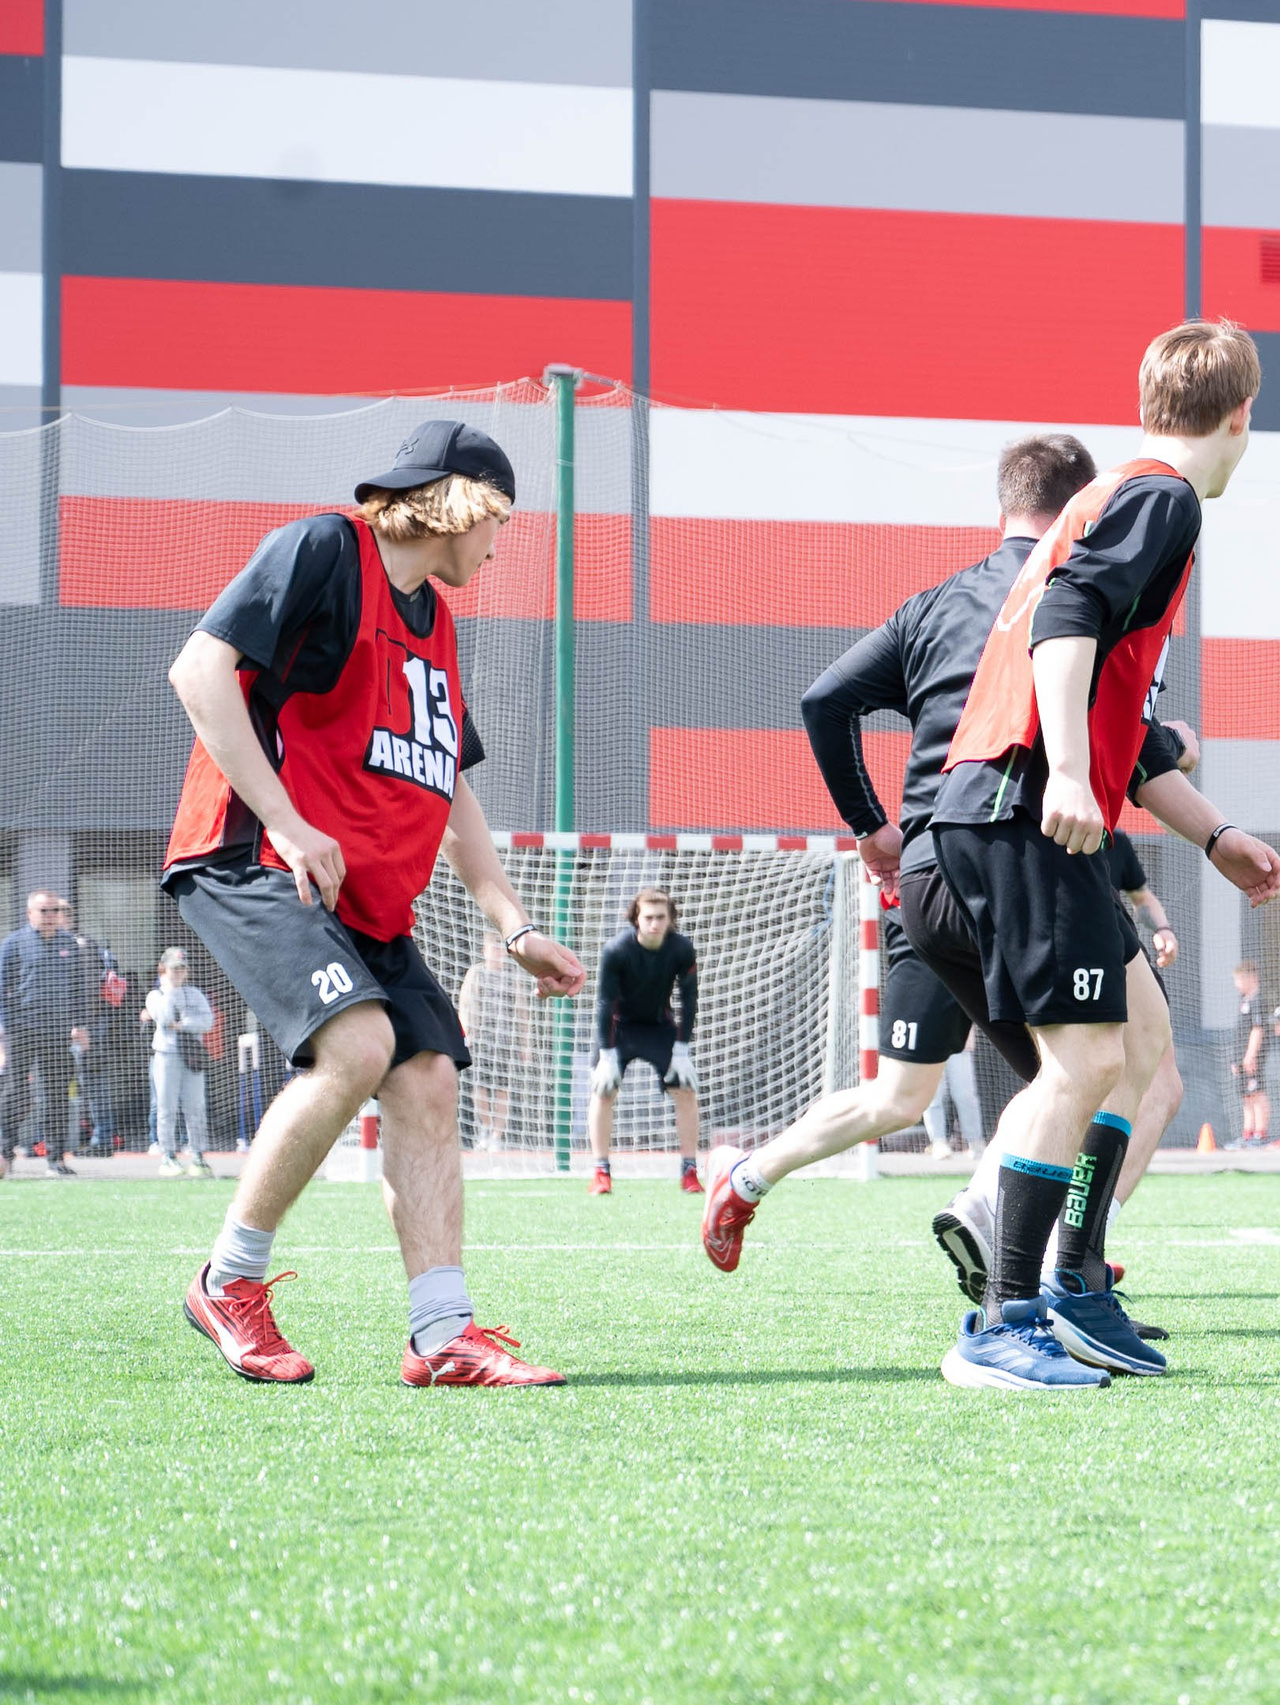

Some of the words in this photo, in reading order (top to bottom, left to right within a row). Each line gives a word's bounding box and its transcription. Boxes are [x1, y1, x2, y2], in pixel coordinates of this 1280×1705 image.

[368, 730, 456, 798] ARENA
[311, 962, 354, 1005] 20
[1073, 967, 1105, 1001] 87
[891, 1019, 918, 1050] 81
